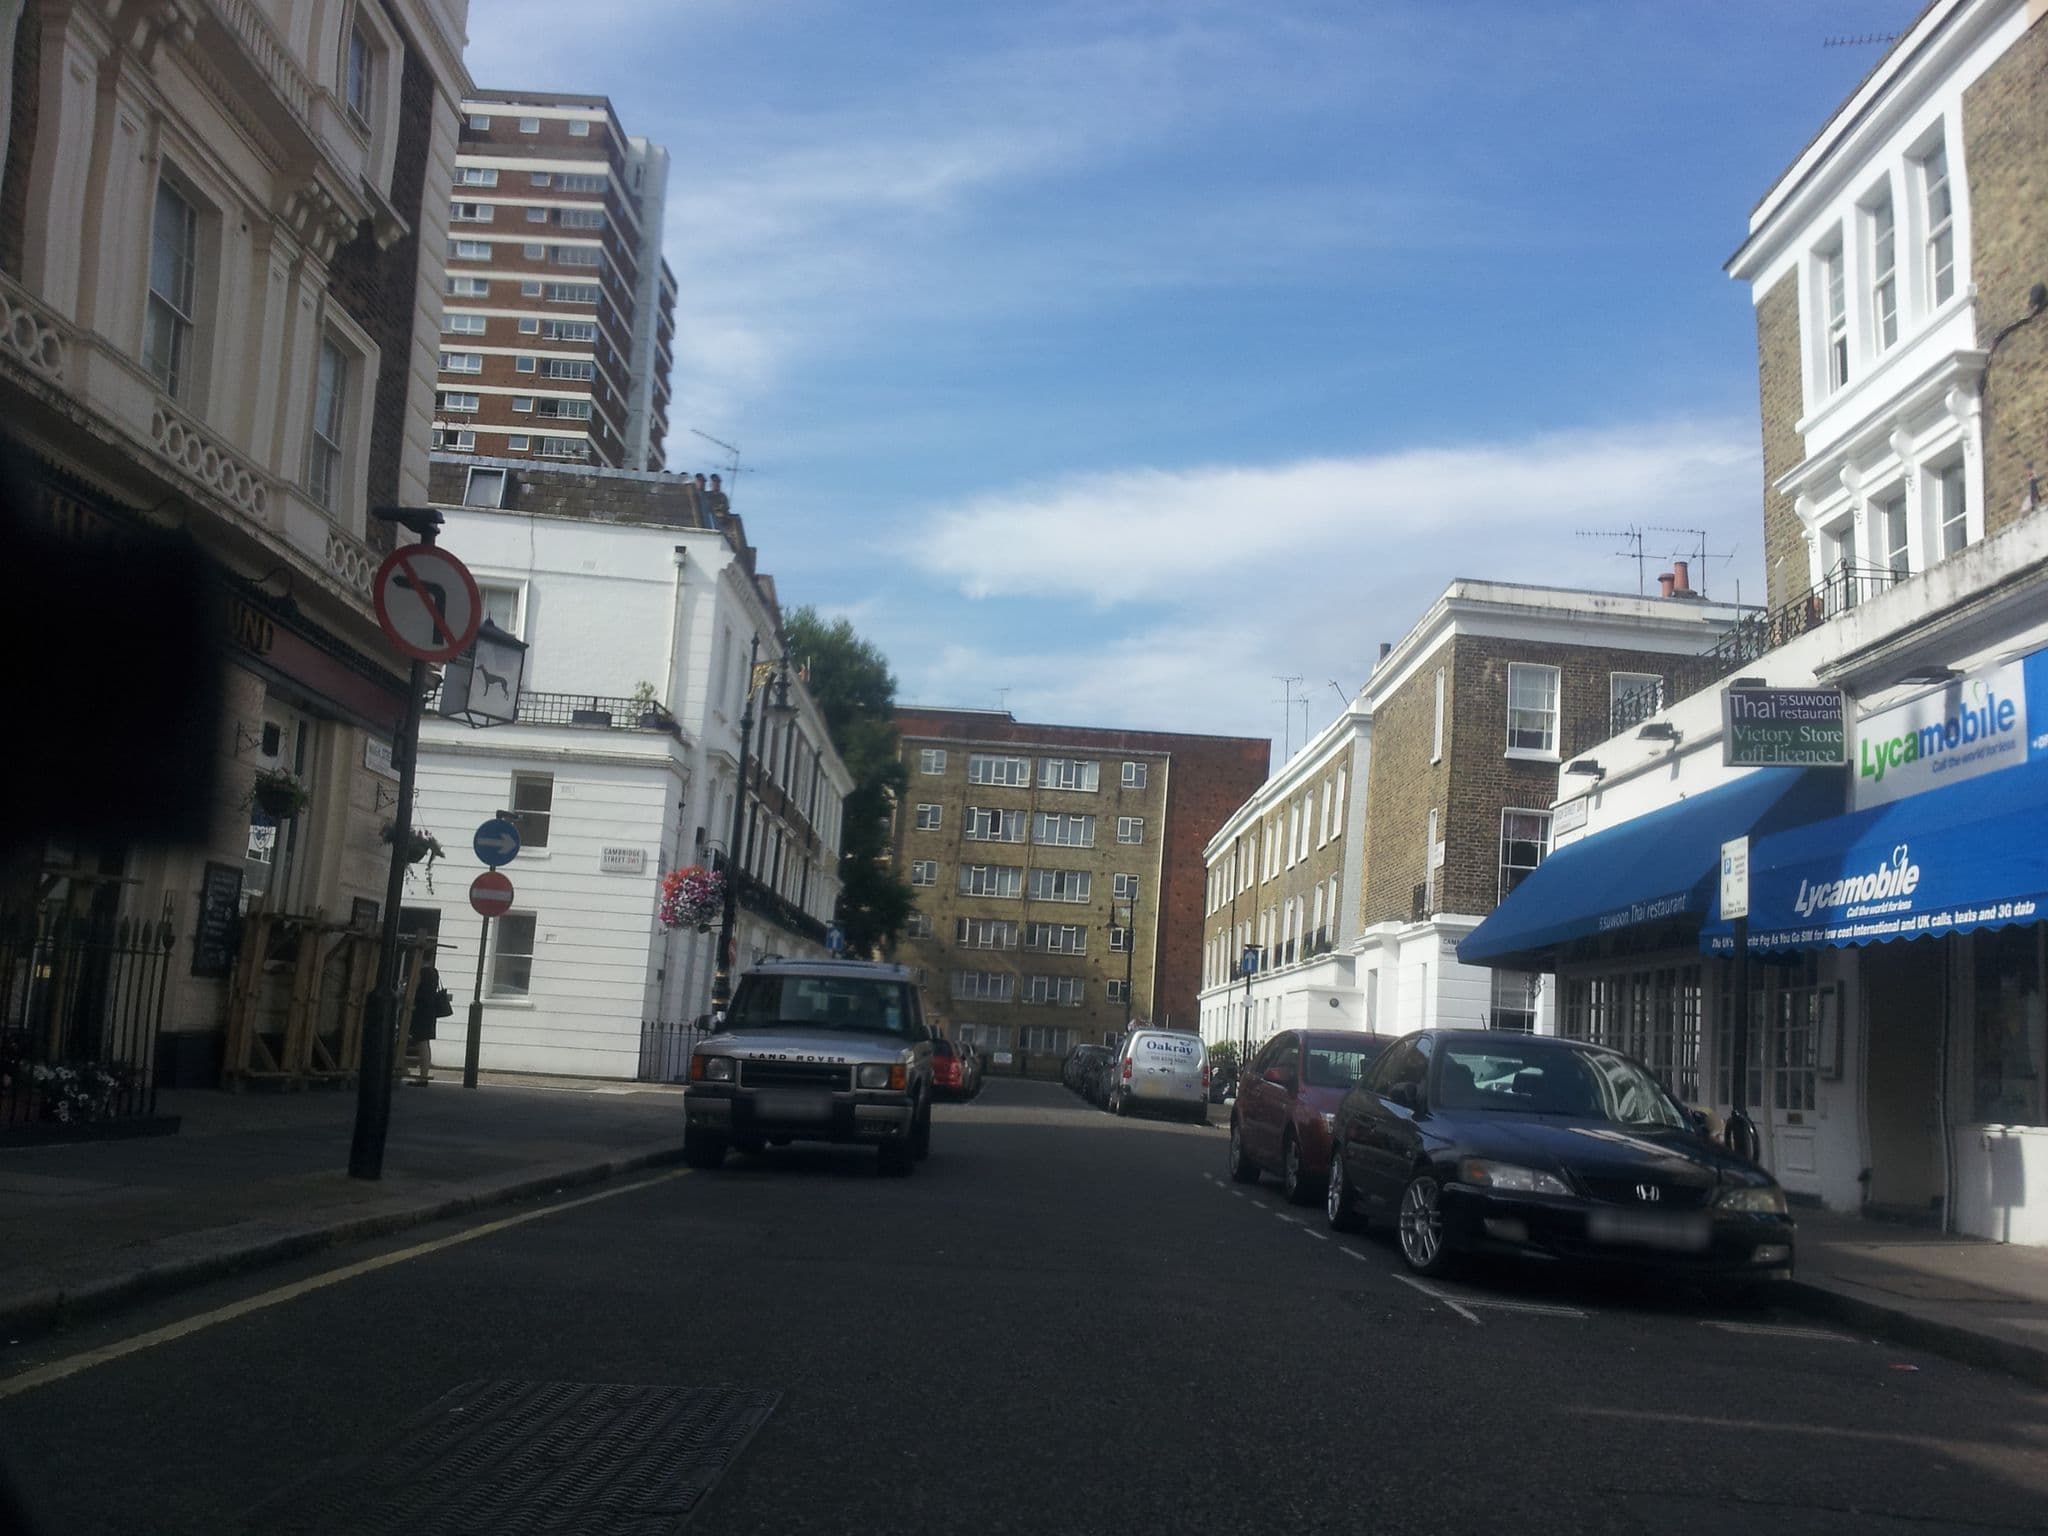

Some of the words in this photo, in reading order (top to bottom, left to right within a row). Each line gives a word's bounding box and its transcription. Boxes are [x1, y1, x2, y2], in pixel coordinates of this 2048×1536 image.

[1730, 694, 1777, 719] Thai
[1788, 694, 1842, 706] suwoon
[1780, 708, 1844, 720] restaurant
[1733, 725, 1794, 746] Victory
[1800, 725, 1844, 743] Store
[1861, 692, 2015, 783] Lycamobile
[1740, 744, 1837, 763] off-licence
[603, 847, 640, 857] CAMBRIDGE
[603, 855, 625, 865] STREET
[1795, 857, 1920, 918] Lycamobile
[1647, 892, 1687, 919] restaurant
[1759, 935, 1770, 948] Pay
[1770, 934, 1779, 945] As
[1779, 933, 1791, 945] You
[1791, 932, 1800, 943] Go
[1801, 930, 1814, 943] SIM
[1814, 929, 1824, 941] for
[1824, 928, 1837, 940] low
[1837, 926, 1853, 938] cost
[1900, 915, 1917, 931] and
[1917, 914, 1931, 929] UK
[1978, 904, 1998, 921] and
[1997, 903, 2013, 918] 3G
[2013, 900, 2036, 916] data
[1146, 1040, 1194, 1056] Oakray
[749, 1052, 787, 1061] LAND
[796, 1055, 846, 1064] ROVER
